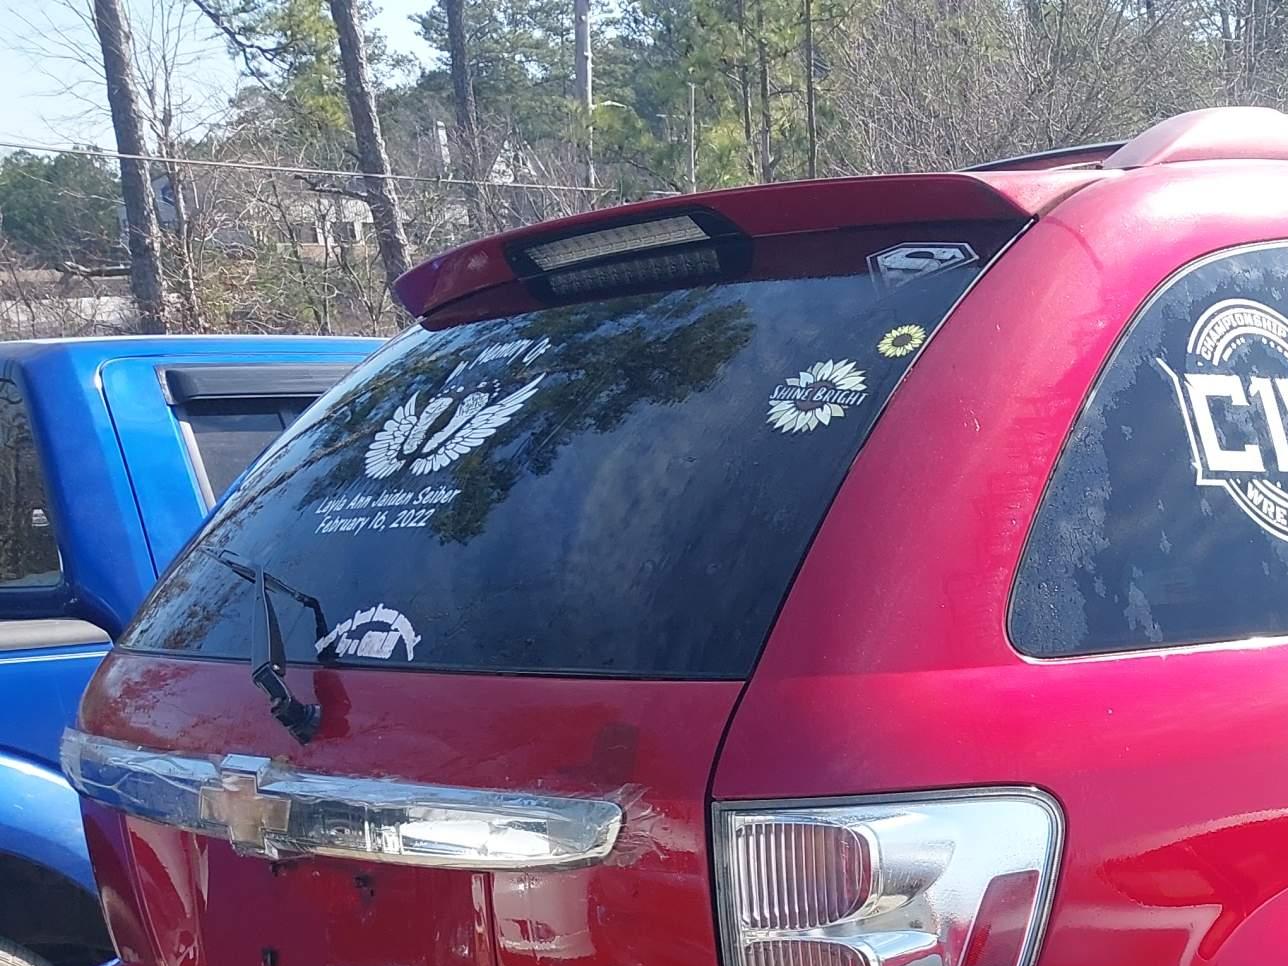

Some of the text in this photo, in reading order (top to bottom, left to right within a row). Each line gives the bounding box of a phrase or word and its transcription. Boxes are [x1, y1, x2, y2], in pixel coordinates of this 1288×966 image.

[1201, 312, 1286, 360] CHAMPIONSHIP
[468, 338, 534, 370] Memory
[769, 384, 869, 407] SHINE BRIGHT
[314, 485, 462, 517] Layla Ann Jaiden Seiber
[314, 507, 436, 537] February 16, 2022
